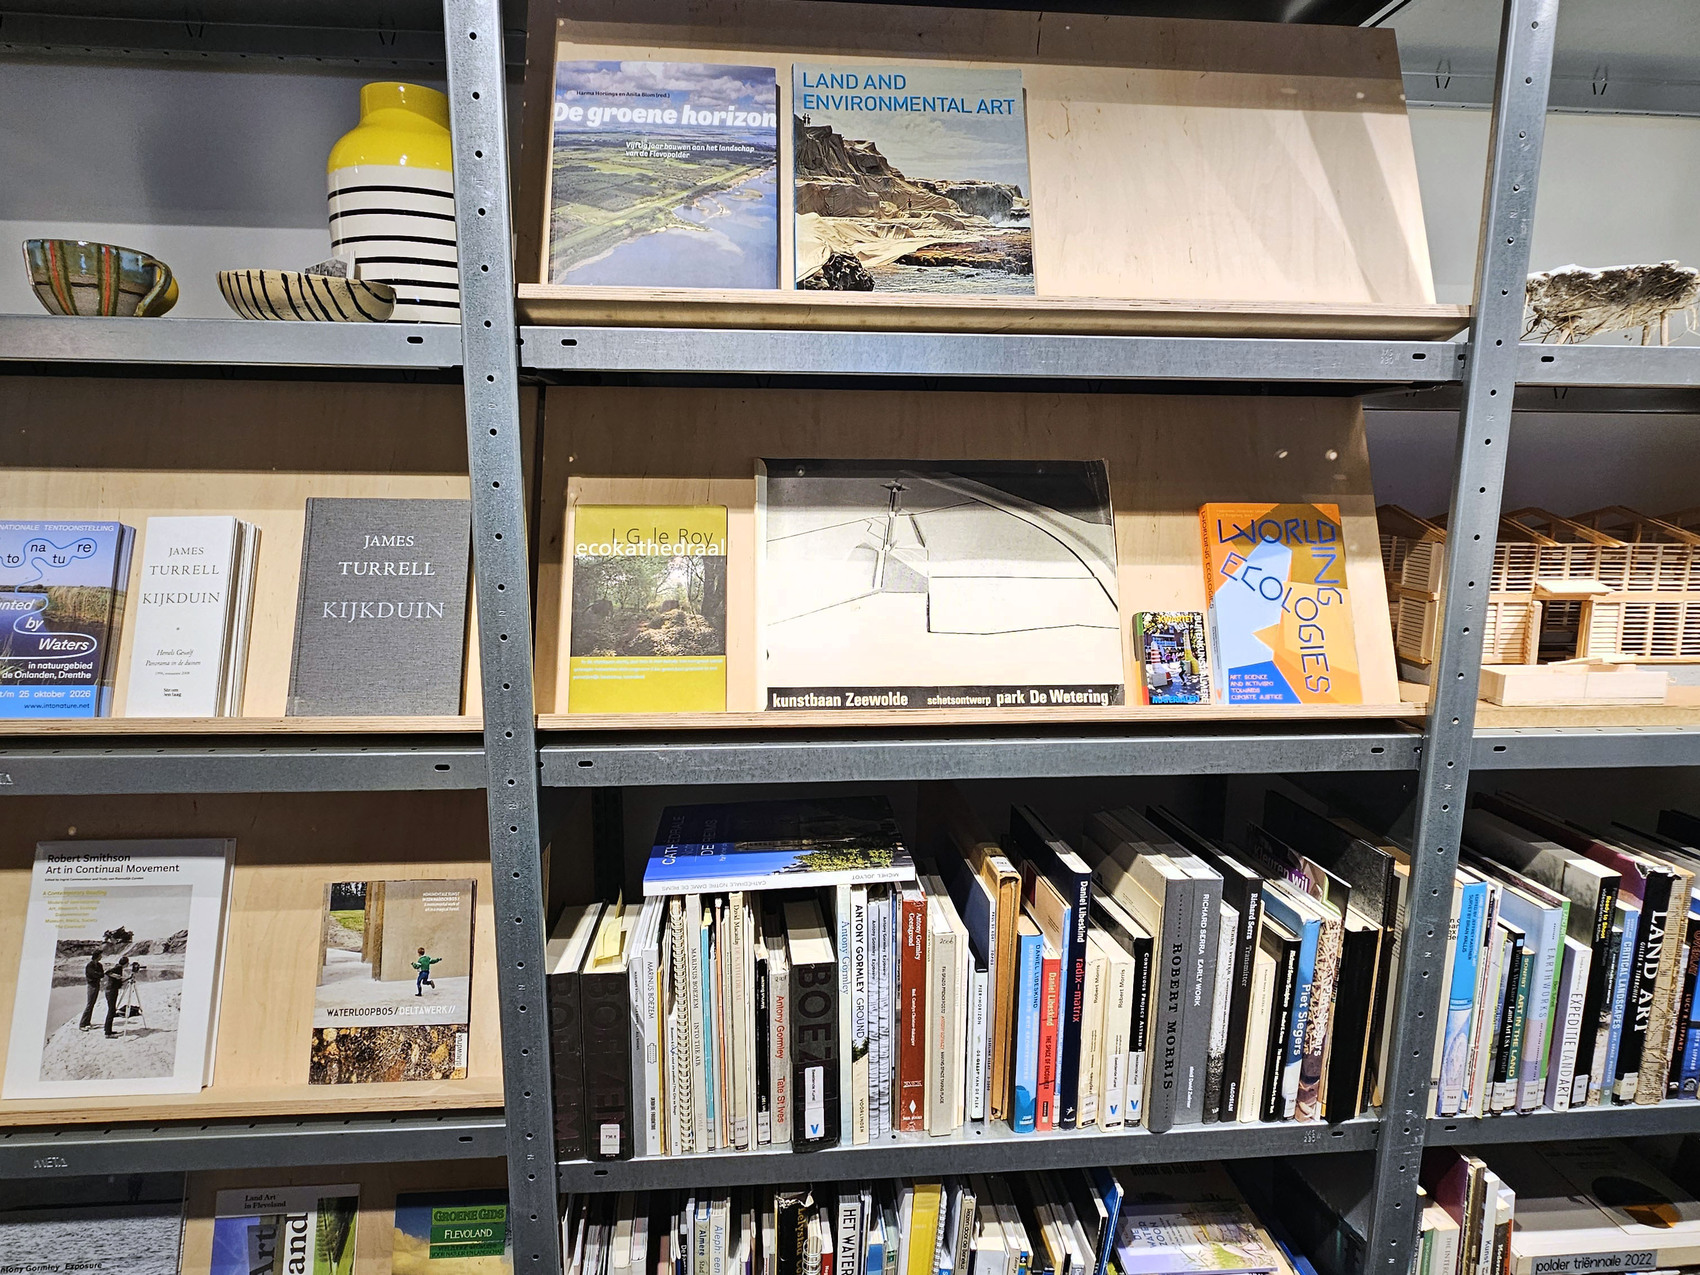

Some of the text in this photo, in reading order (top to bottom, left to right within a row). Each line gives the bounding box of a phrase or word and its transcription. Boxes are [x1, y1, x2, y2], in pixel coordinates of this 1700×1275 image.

[803, 72, 907, 90] LAND AND
[803, 94, 1016, 115] ENVIRONMENTAL ART
[554, 103, 777, 128] De groene horizon
[625, 141, 755, 154] Vijftig bouwen aan het landschap
[638, 150, 690, 159] de Flevopolder
[44, 524, 114, 532] TENTOONSTELLING
[653, 528, 714, 548] le Roy
[30, 543, 46, 553] na
[76, 543, 92, 553] re
[168, 547, 204, 557] JAMES
[363, 535, 415, 549] JAMES
[576, 538, 726, 556] ecokathedraal
[6, 553, 20, 564] to
[52, 553, 66, 564] tu
[150, 565, 220, 576] TURRELL
[338, 562, 436, 576] TURRELL
[142, 592, 220, 606] KIJKDUIN
[322, 602, 445, 623] KIJKDUIN
[25, 617, 44, 632] by
[38, 638, 90, 651] Waters
[14, 671, 57, 680] Onlanden,
[58, 671, 92, 679] Drenthe
[38, 662, 93, 672] natuurgebied
[18, 690, 91, 698] 25 oktober 2026
[772, 688, 1109, 708] kunstbaan Zeewolde schetsontwerp park De Wetering
[48, 854, 130, 863] Robert Smithson
[46, 864, 180, 874] Art in Continual Movement
[1077, 880, 1088, 943] Daniel Libeskind
[1466, 894, 1474, 914] SURVEY
[1604, 896, 1612, 913] Ready
[1595, 888, 1607, 942] videogalerie schum
[914, 912, 922, 960] Antony Gormley
[1242, 893, 1258, 987] Richard Serra Transmitter
[1600, 922, 1609, 939] Shoot
[840, 920, 850, 995] Antony Gormley
[1194, 894, 1210, 1006] RICHARD SERRA EARLY WORK
[1288, 950, 1296, 968] Richard
[1618, 941, 1632, 976] CRITICAL
[855, 904, 864, 1038] ANTONY GORMLEY GROUND
[1142, 952, 1150, 991] CONTINUOUS
[1521, 958, 1530, 988] SONFIST
[1634, 910, 1664, 1032] LAND ART
[1538, 948, 1556, 1018] EARTHWORKS
[1632, 970, 1642, 1003] TIBERGHIEN
[1046, 972, 1056, 1026] Daniel Libeskind
[1518, 994, 1526, 1014] ART
[1612, 978, 1628, 1029] LANDSCAPES
[1163, 943, 1182, 1090] ROBERT MORRIS
[1294, 984, 1311, 1056] Piet Siegers
[1516, 1016, 1522, 1026] IN
[1504, 1036, 1512, 1048] USA
[1557, 993, 1583, 1098] EXPEDITIE LAND ART
[1677, 1022, 1687, 1052] LIPPARD
[776, 995, 786, 1124] Antony Gormley Tate St Ives
[1509, 1050, 1518, 1077] LAND
[1690, 1048, 1698, 1070] LIPPARD
[1228, 1082, 1236, 1112] GAGOSIAN
[245, 1194, 262, 1202] Land
[252, 1200, 286, 1208] Flevoland
[434, 1208, 504, 1222] GROENE GIDS
[842, 1208, 856, 1231] HET
[444, 1228, 492, 1240] FLEVOLAND
[698, 1230, 706, 1256] Almere
[712, 1224, 722, 1254] Aleph:
[1132, 1230, 1142, 1241] DE
[1150, 1222, 1168, 1246] ZOON
[1484, 1240, 1492, 1264] Kunst
[26, 1262, 102, 1274] Gormley Exposure
[1536, 1253, 1653, 1272] polder triënnale 2022
